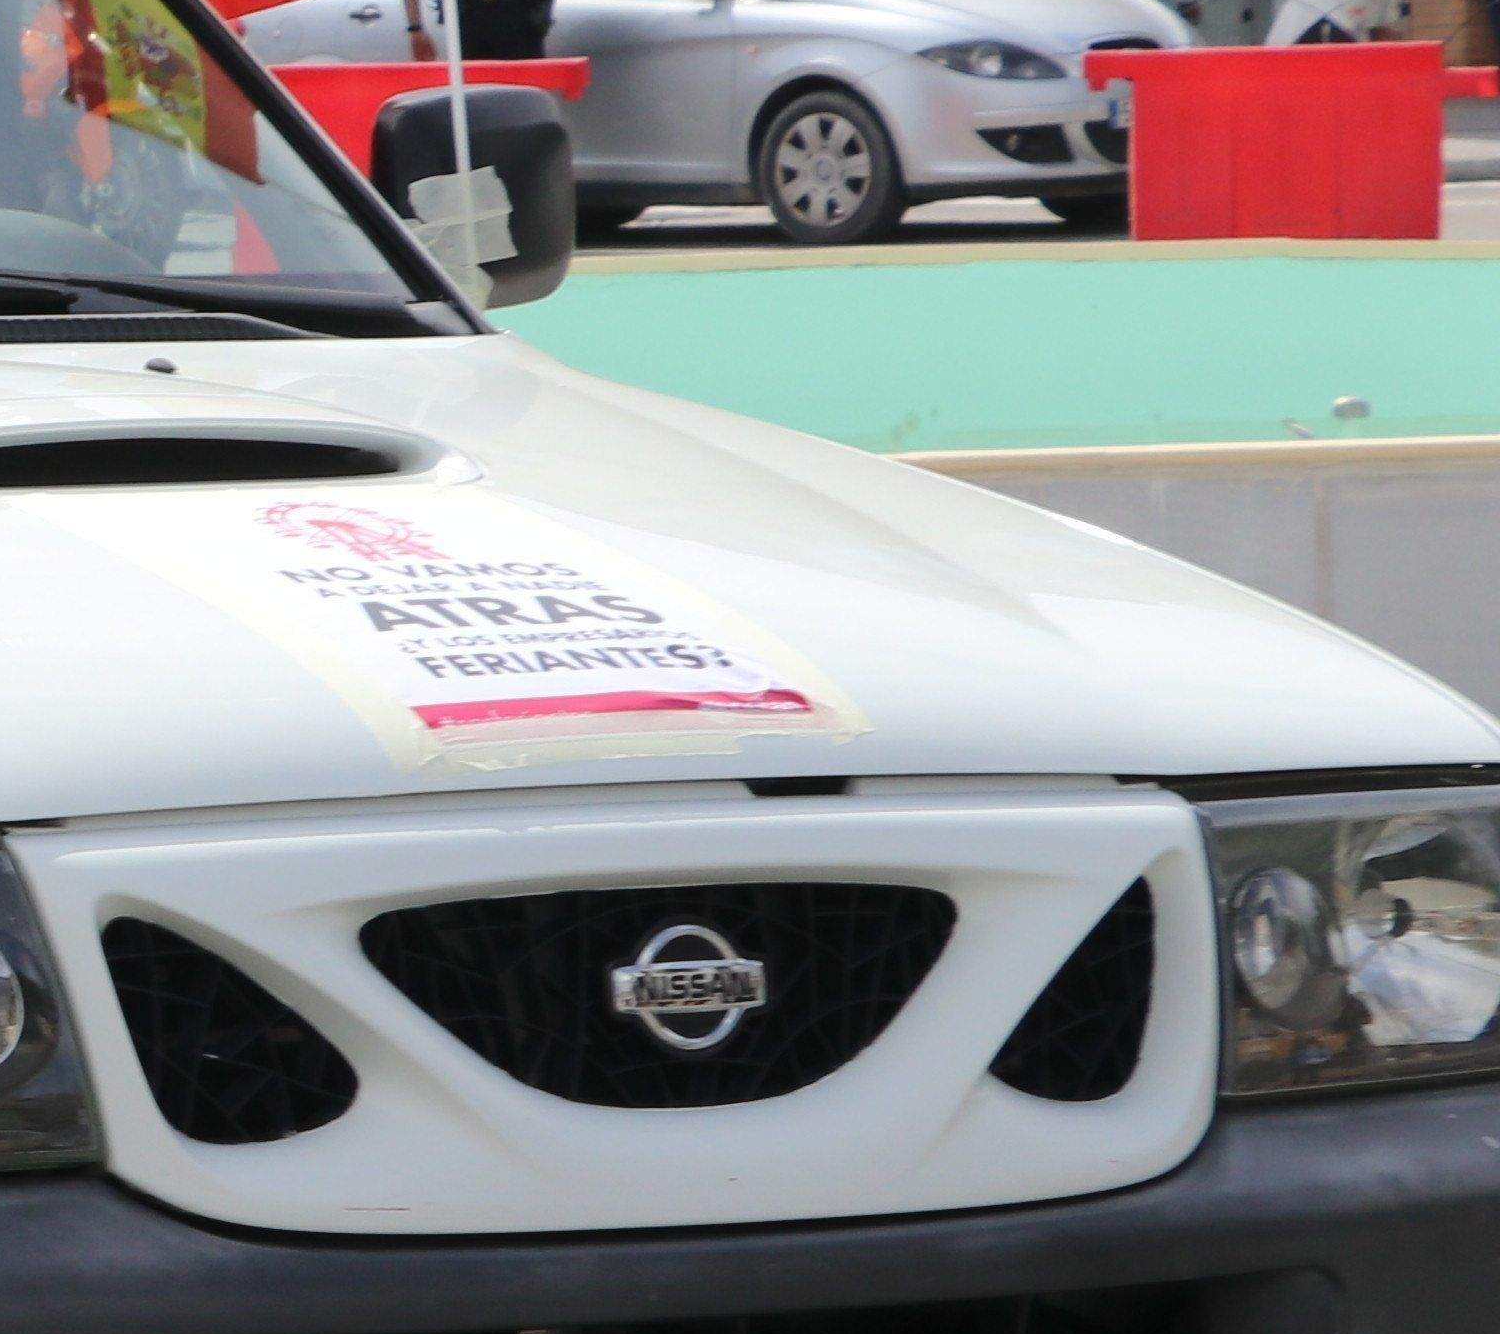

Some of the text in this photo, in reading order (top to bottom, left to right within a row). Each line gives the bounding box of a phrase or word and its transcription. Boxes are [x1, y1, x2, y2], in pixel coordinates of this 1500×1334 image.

[278, 562, 581, 584] NO VAMOS
[348, 582, 460, 596] DEJAR
[360, 595, 664, 632] ATRAS
[435, 635, 495, 647] LOS
[415, 642, 732, 679] FERIANTES?
[633, 966, 759, 1010] NISSAN
